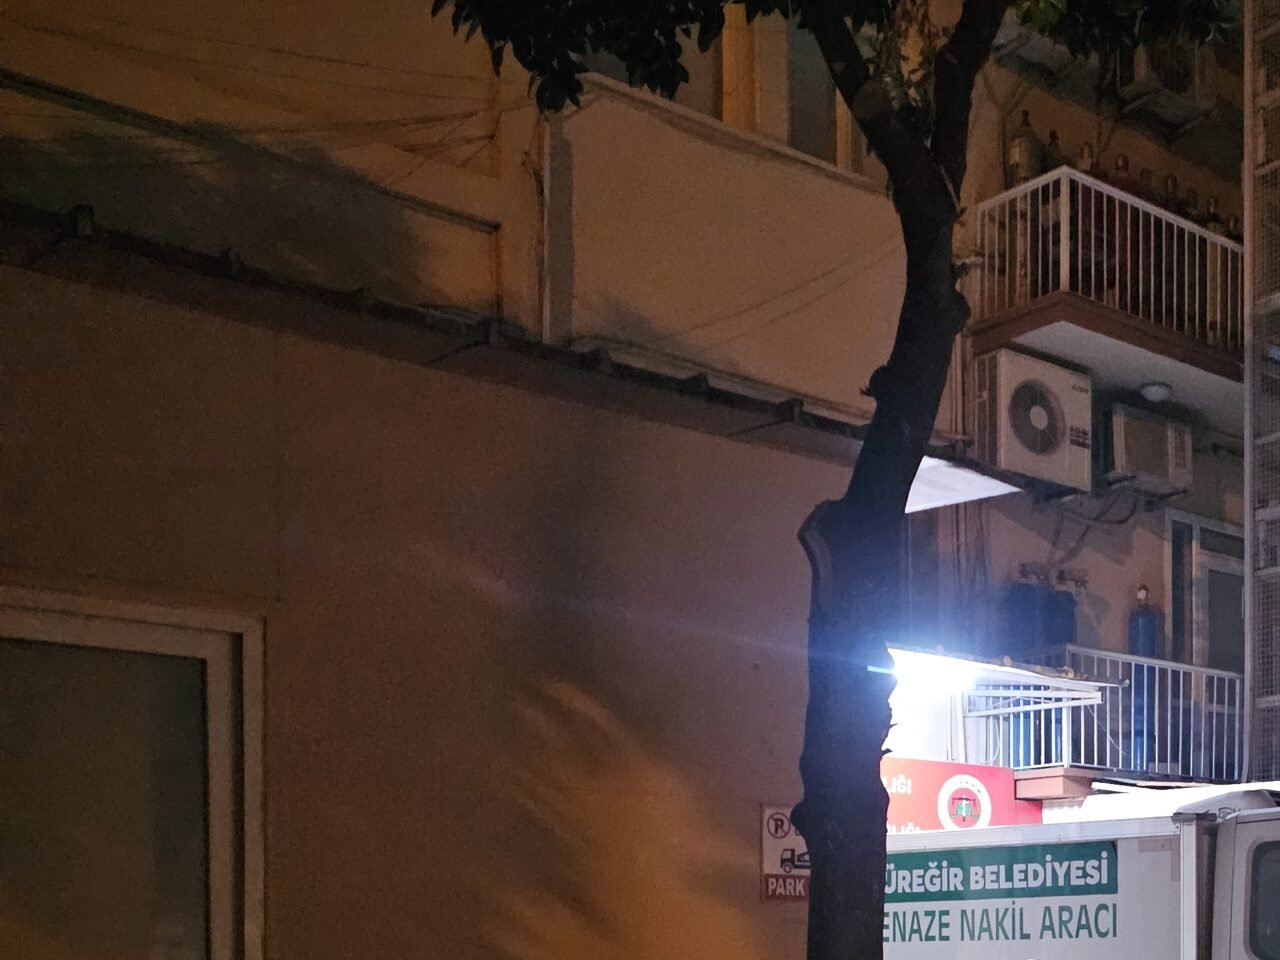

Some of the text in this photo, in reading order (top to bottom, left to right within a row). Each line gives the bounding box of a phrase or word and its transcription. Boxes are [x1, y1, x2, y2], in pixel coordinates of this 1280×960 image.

[768, 878, 806, 896] PARK
[969, 851, 1109, 891] BELEDİYESİ
[960, 900, 1031, 941] NAKİL
[1039, 902, 1117, 940] ARACI
